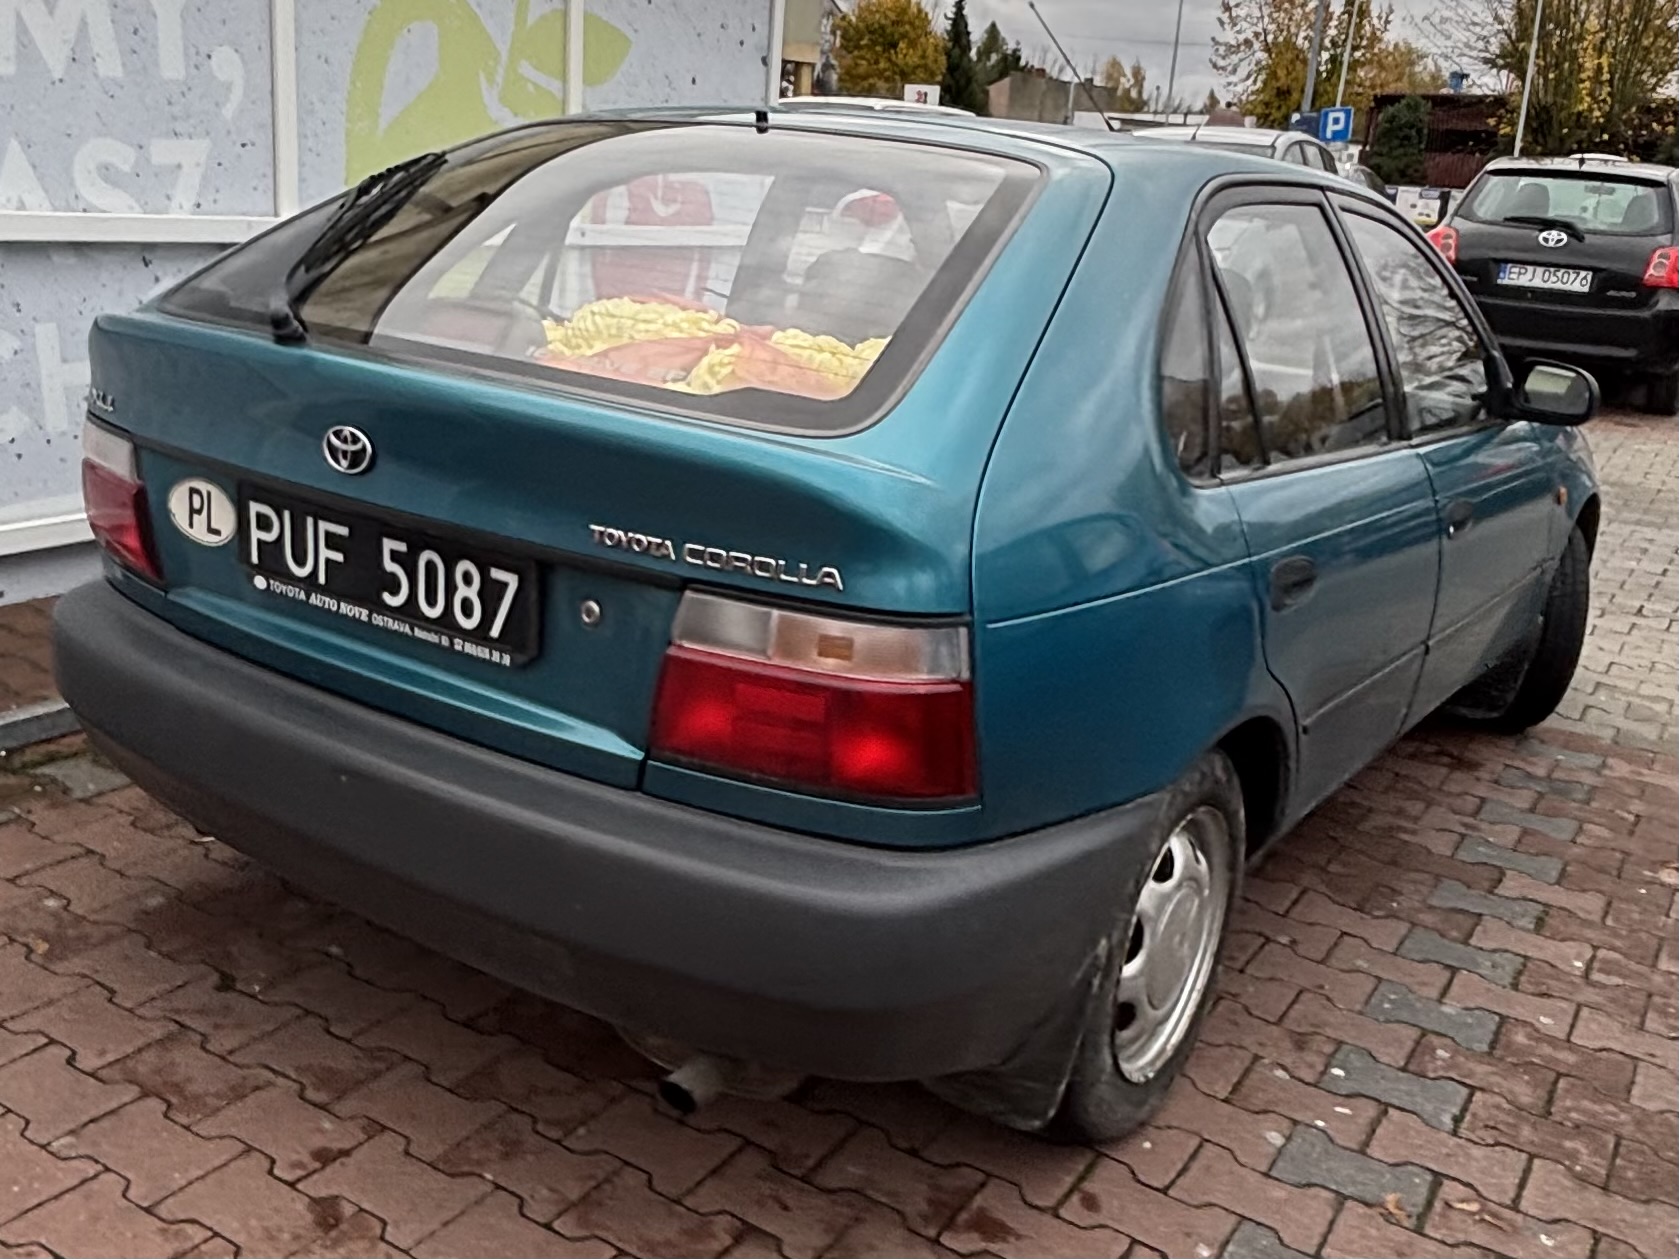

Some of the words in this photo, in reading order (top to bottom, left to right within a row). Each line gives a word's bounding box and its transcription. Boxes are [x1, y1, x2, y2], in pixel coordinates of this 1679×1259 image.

[1325, 111, 1346, 139] P
[1507, 265, 1537, 282] EPJ
[1541, 269, 1590, 288] 05076
[188, 486, 222, 537] PL
[248, 500, 350, 585] PUF
[381, 537, 519, 639] 5087
[588, 523, 676, 561] TOYOTA
[683, 543, 844, 591] COROLLA
[268, 579, 307, 602] TOYOTA
[308, 592, 338, 612] AUTO
